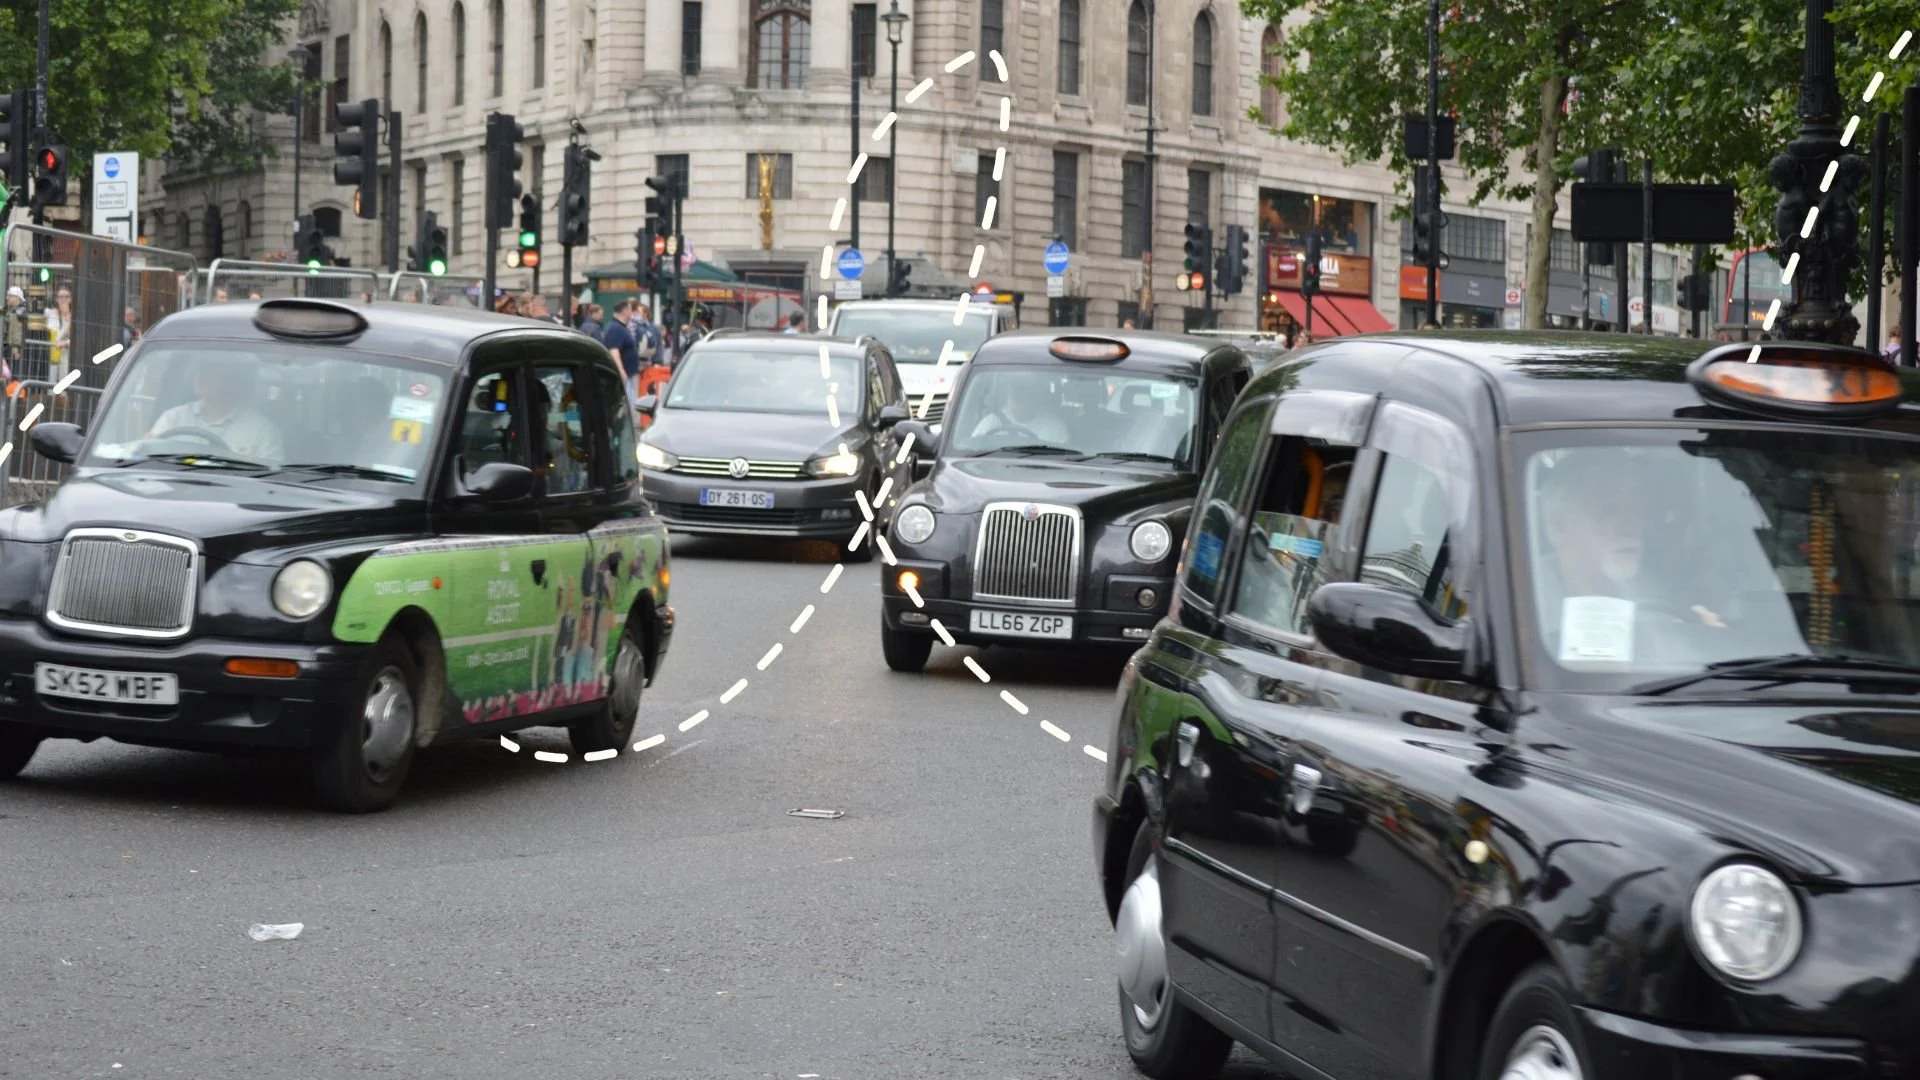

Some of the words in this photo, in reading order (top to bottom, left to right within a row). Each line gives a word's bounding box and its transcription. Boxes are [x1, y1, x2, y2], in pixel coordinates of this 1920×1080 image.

[488, 580, 520, 600] ROYAL
[486, 602, 520, 625] ASCOT
[979, 611, 1024, 631] LL66
[1029, 616, 1064, 633] ZGP
[45, 667, 108, 697] SK52
